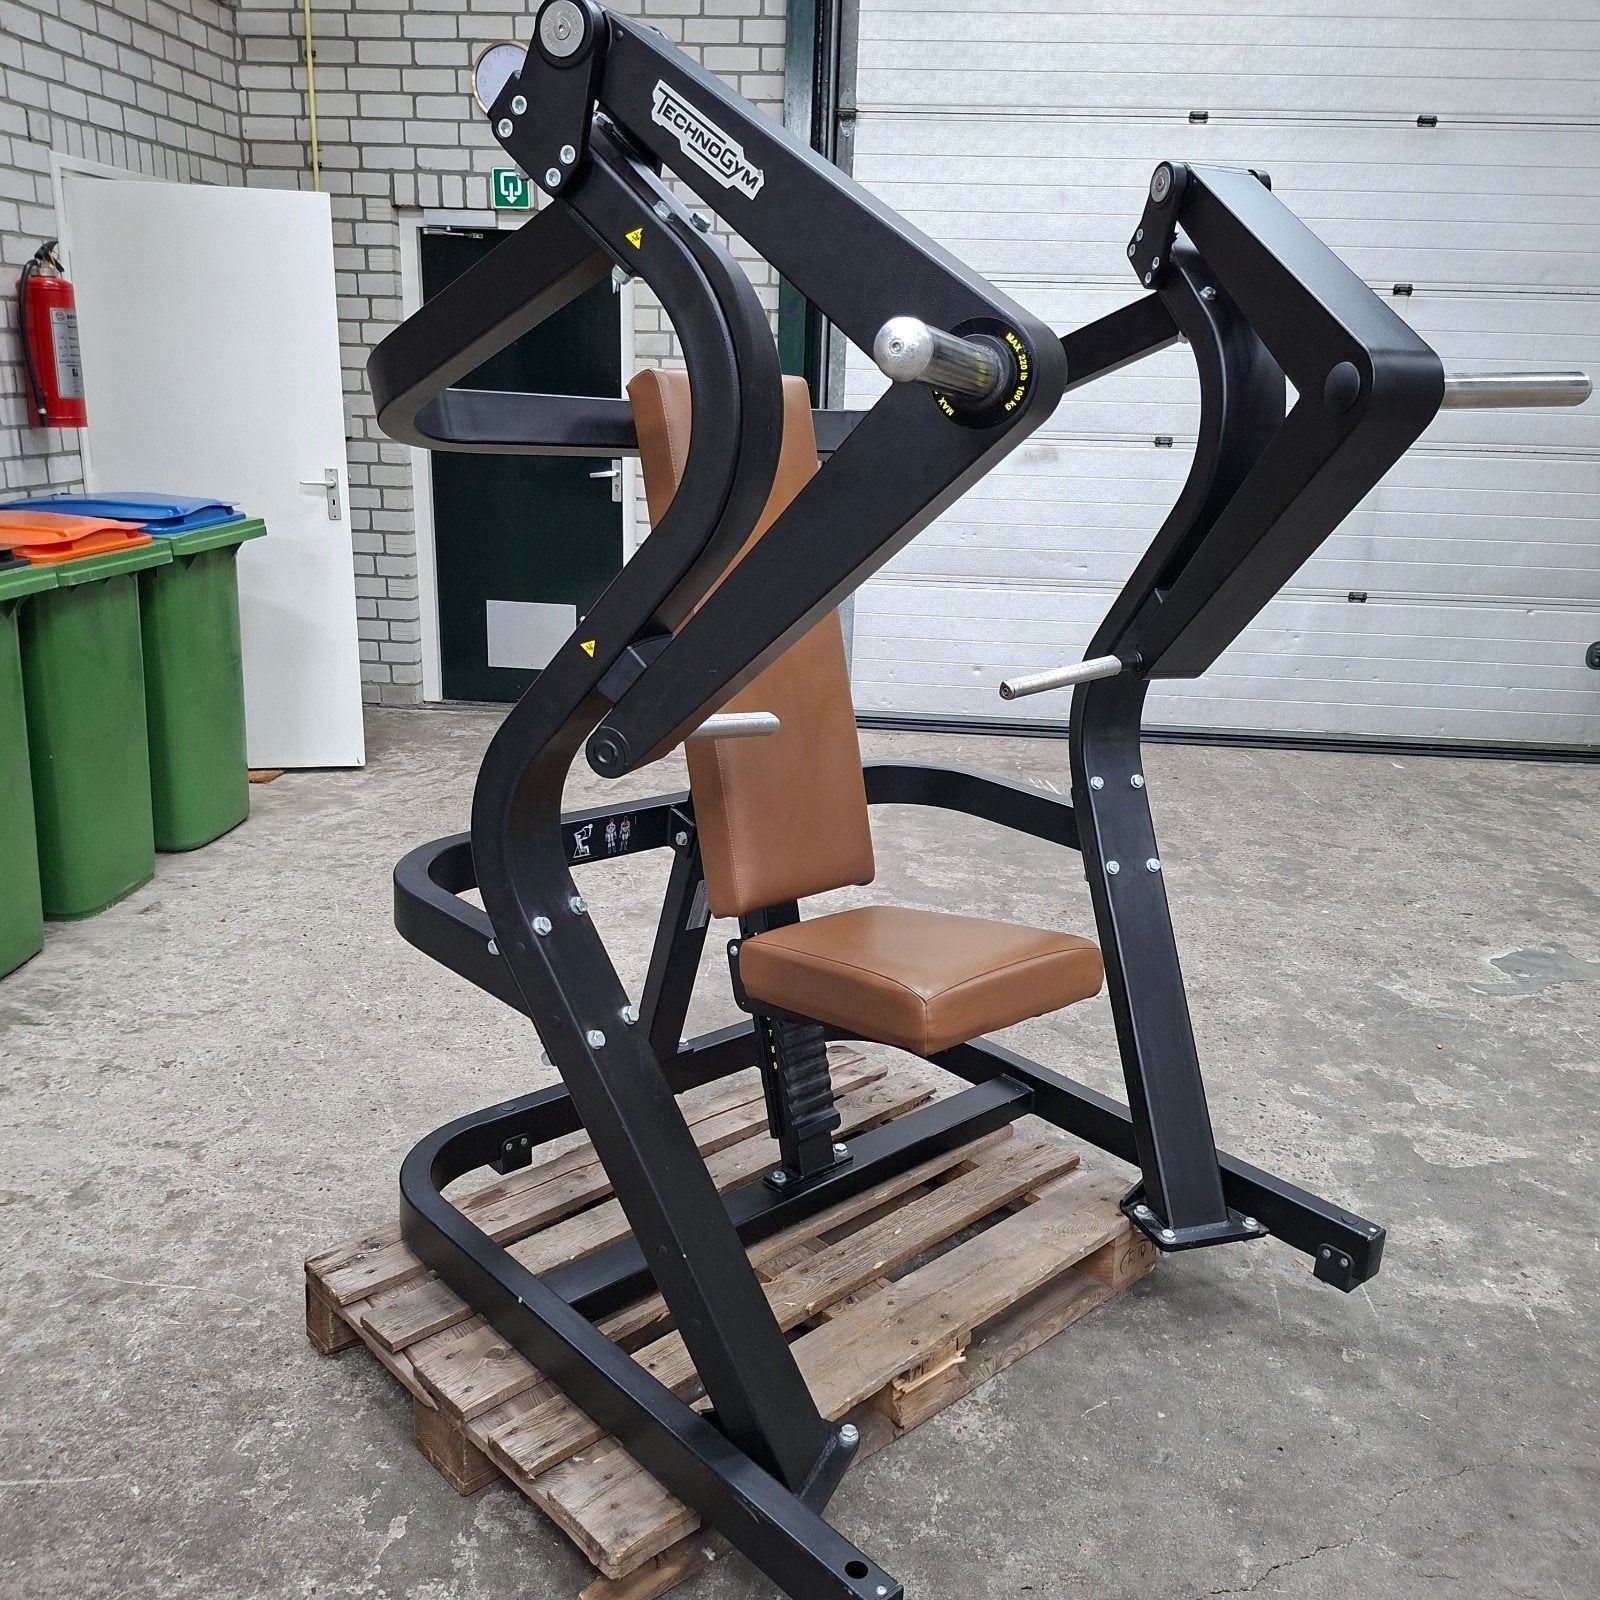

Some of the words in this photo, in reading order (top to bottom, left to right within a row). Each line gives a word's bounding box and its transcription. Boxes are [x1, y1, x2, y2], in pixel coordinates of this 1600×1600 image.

[505, 47, 514, 57] 12
[483, 59, 491, 71] 10
[657, 86, 760, 190] TECHNOGYM
[1005, 332, 1023, 353] MAX
[1018, 354, 1028, 371] 220
[1020, 372, 1028, 381] lb
[1013, 386, 1025, 401] 100
[938, 396, 954, 416] MAX
[1004, 400, 1017, 411] kg
